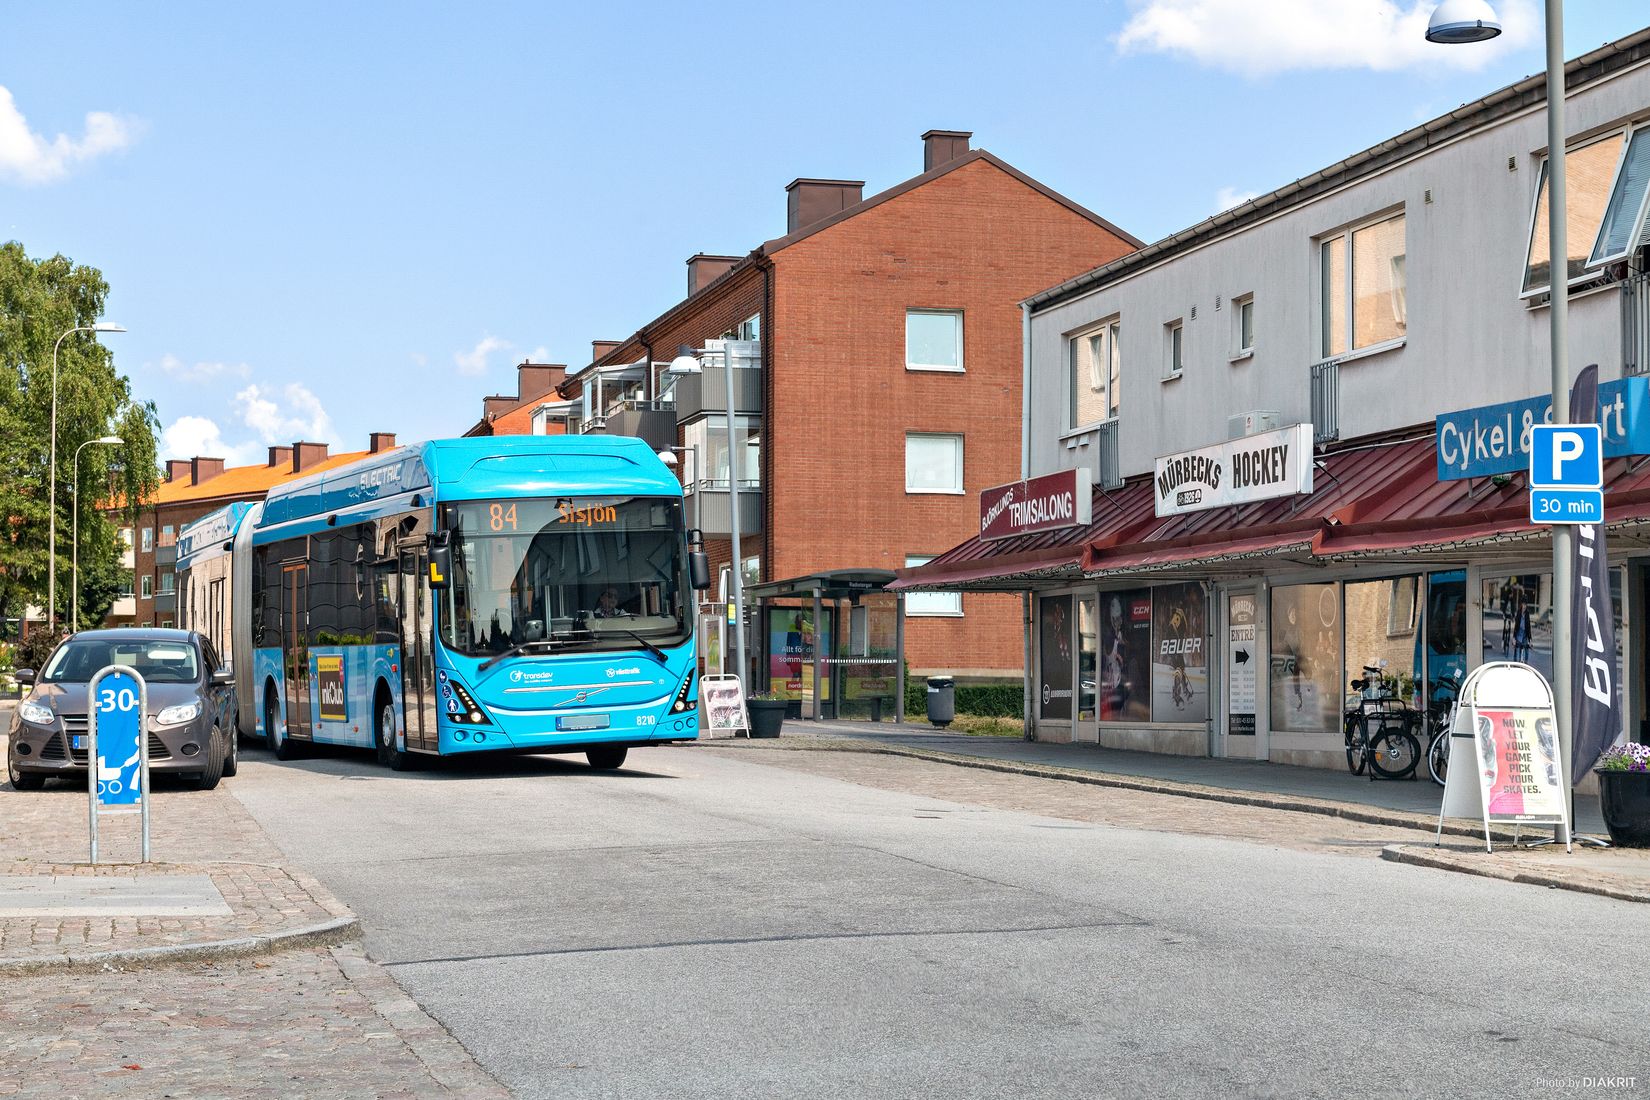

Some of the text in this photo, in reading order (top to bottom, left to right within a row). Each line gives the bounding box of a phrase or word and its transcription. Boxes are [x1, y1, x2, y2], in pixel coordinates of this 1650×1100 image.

[1441, 413, 1513, 470] Cykel
[1552, 432, 1584, 480] P
[1158, 444, 1288, 500] MÜRBECKS HOCKEY
[982, 487, 1014, 531] BJÖRKLUNDS
[1008, 491, 1073, 527] TRIMSALONG
[1540, 498, 1594, 513] 30 min
[489, 502, 616, 531] 84 Sisjön
[1230, 625, 1255, 642] ENTRÉ
[1160, 637, 1202, 655] BAUER
[101, 689, 134, 712] 30
[636, 715, 655, 726] 8210
[1509, 731, 1522, 739] LET
[1506, 742, 1530, 751] YOUR
[1506, 753, 1532, 762] GAME
[1509, 764, 1530, 773] PICK
[1509, 775, 1533, 784] YOUR
[1504, 785, 1541, 794] SKATES.
